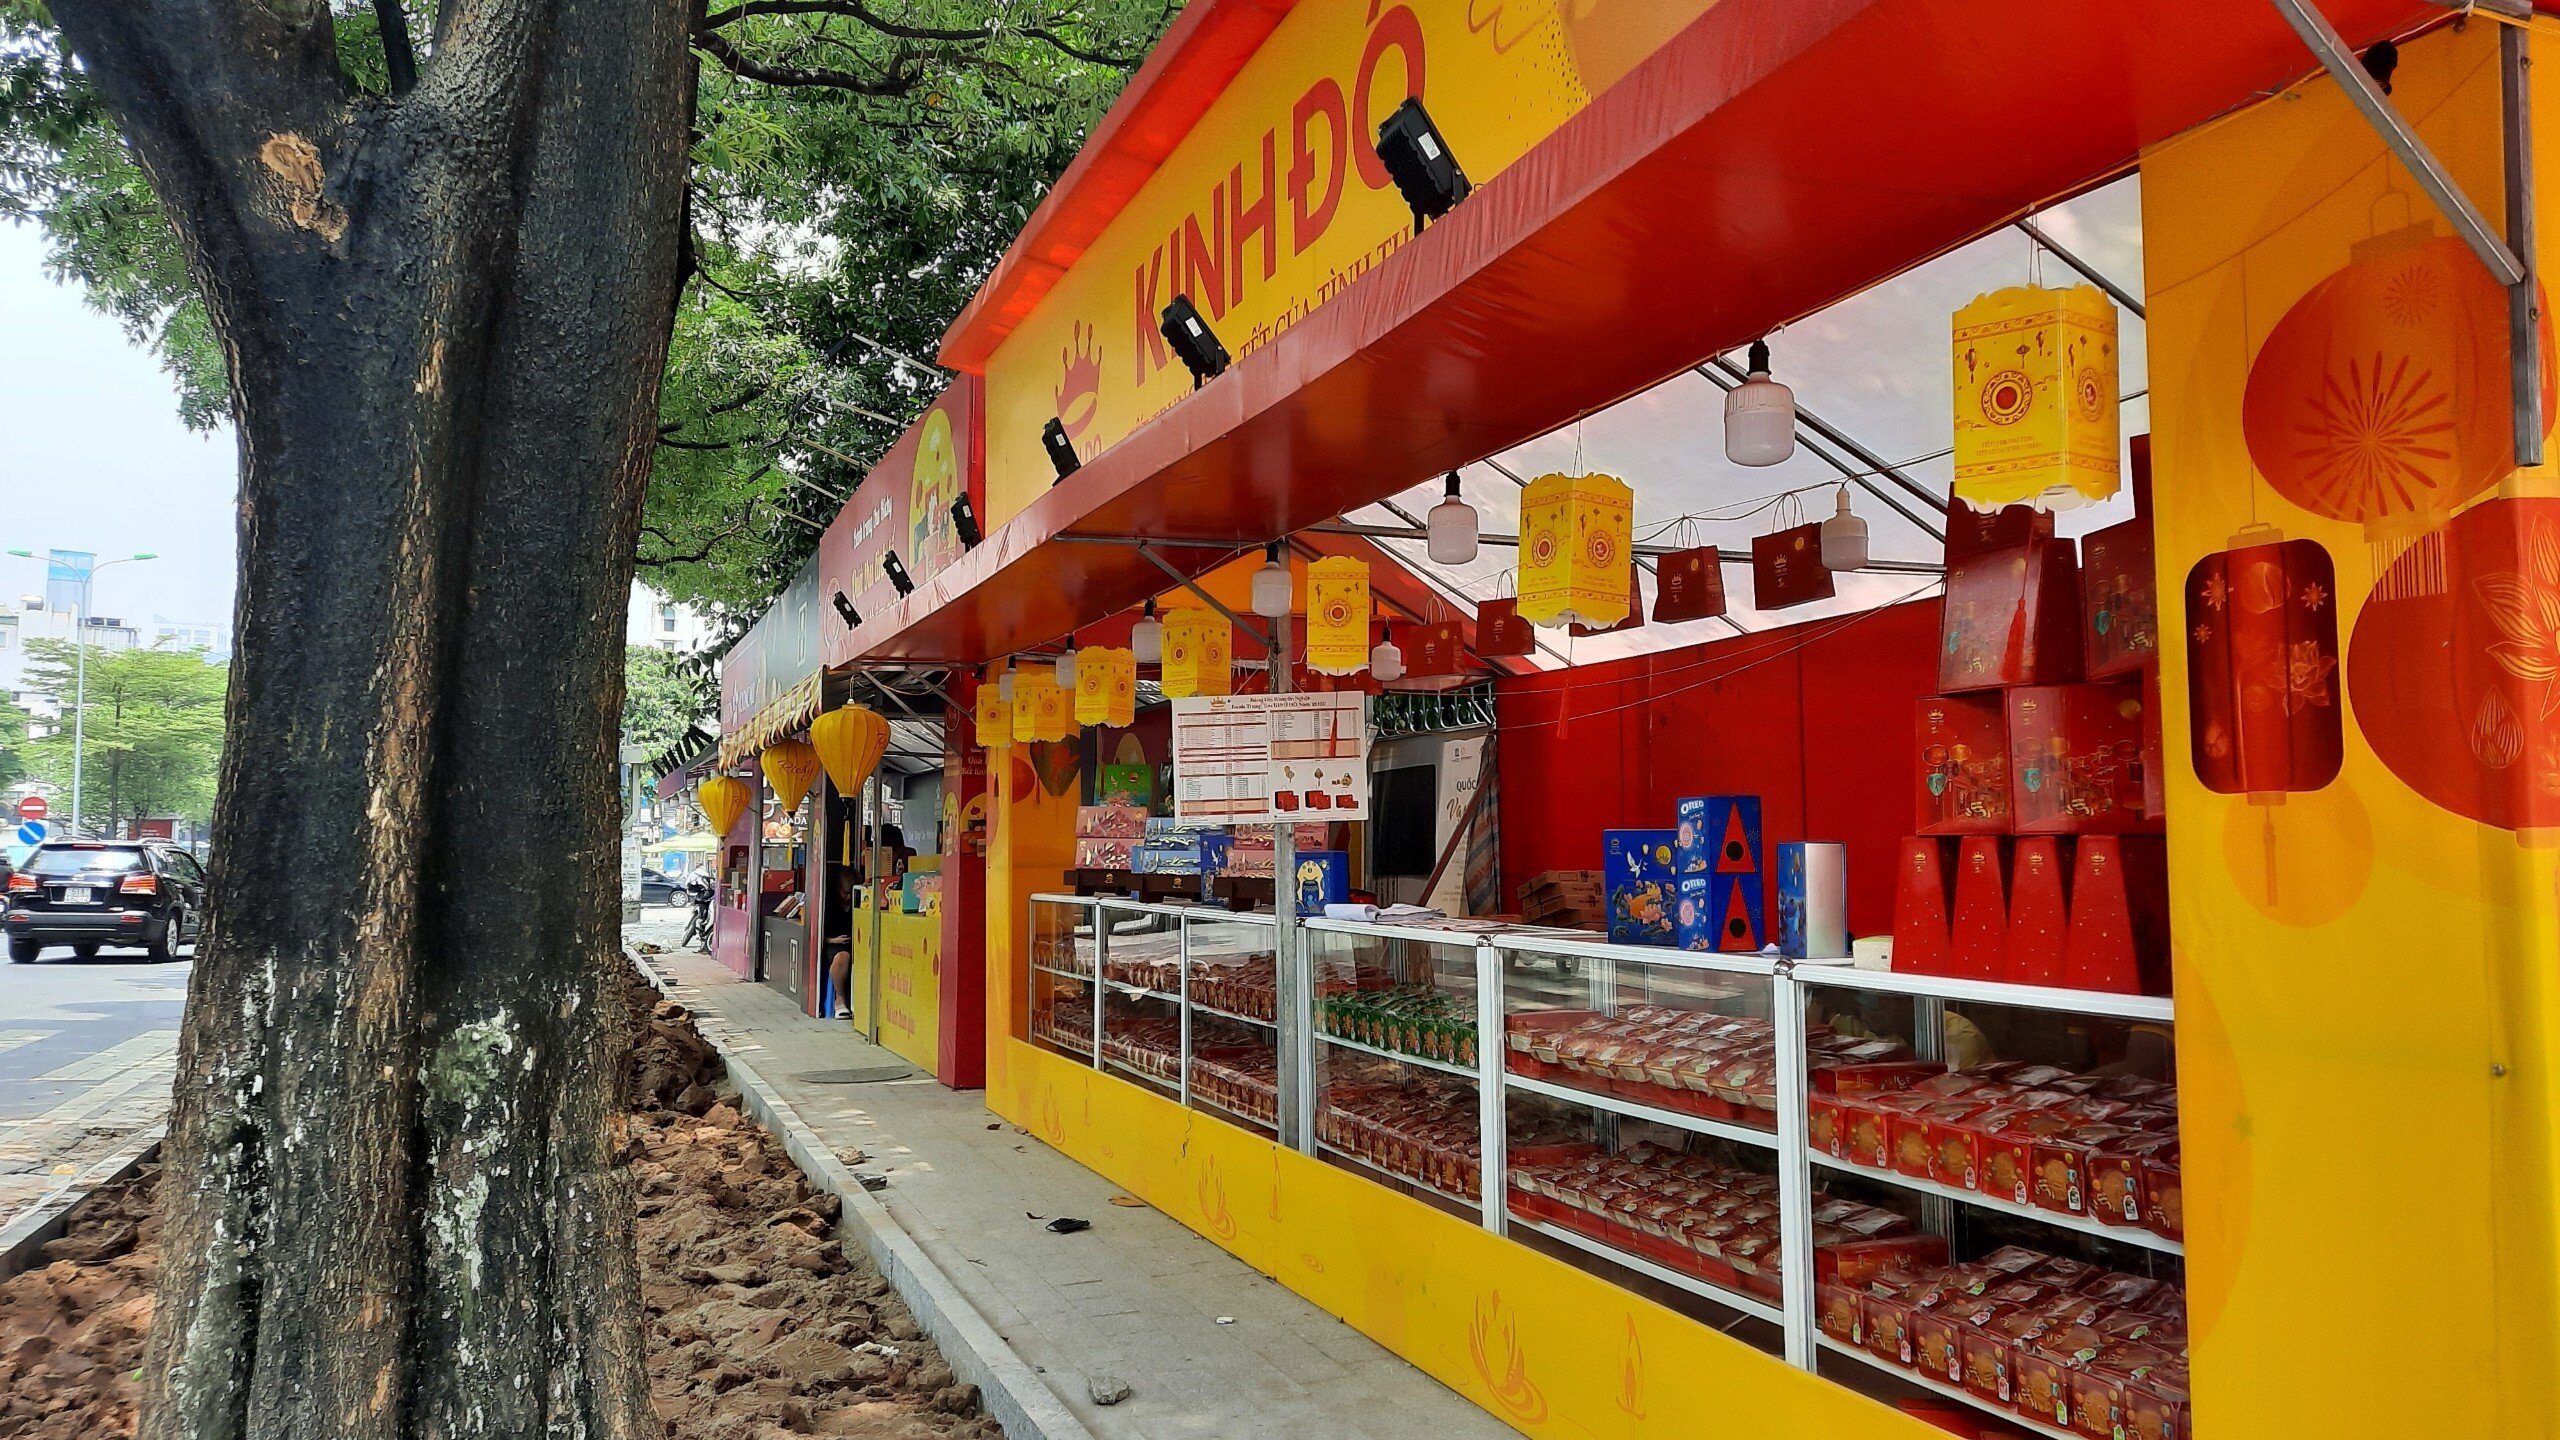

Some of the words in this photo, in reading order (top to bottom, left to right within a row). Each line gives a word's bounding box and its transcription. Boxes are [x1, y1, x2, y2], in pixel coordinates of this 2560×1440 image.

[1134, 126, 1277, 388] KINH
[1680, 799, 1705, 815] OREO
[1681, 877, 1707, 893] OREO
